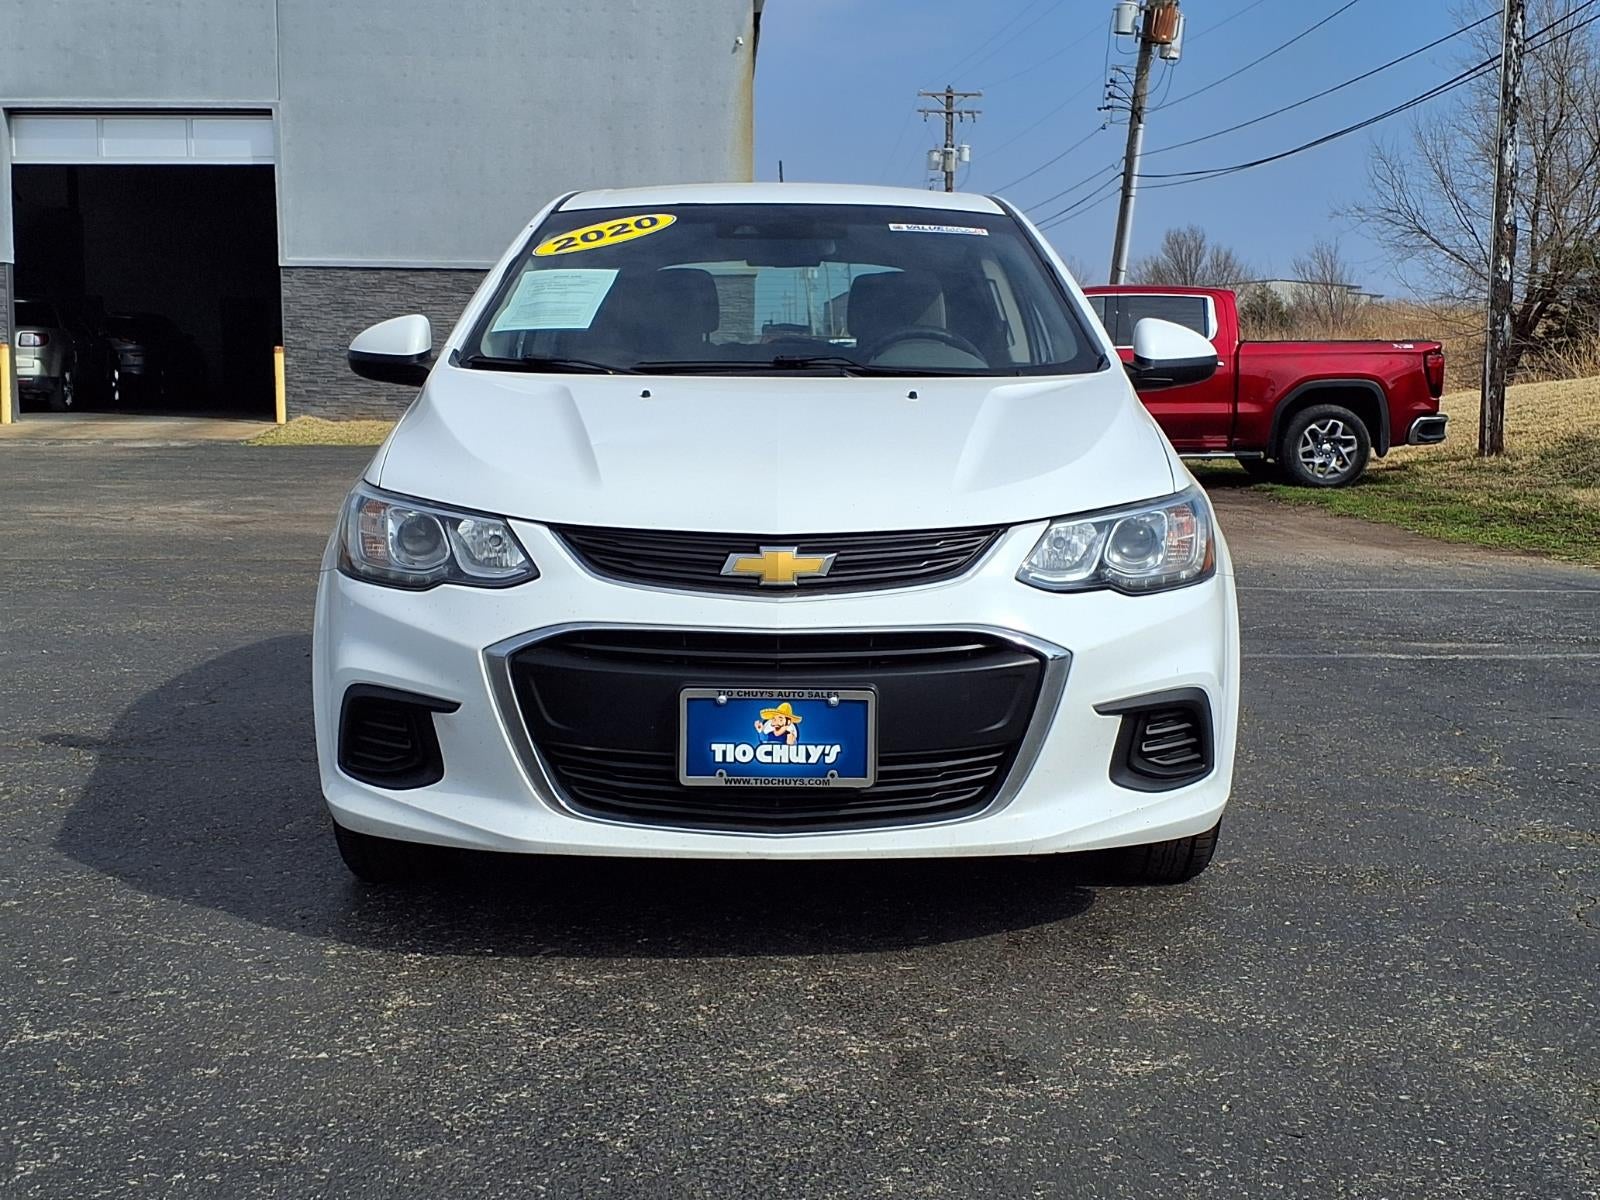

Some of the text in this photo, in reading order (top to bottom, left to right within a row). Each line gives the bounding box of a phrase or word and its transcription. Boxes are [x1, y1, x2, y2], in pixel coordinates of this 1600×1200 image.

[553, 216, 659, 252] 2020
[737, 690, 774, 698] CHUY'S
[807, 691, 840, 699] SALES
[711, 743, 841, 764] TIO CHUY'S
[724, 778, 830, 786] WWW.TIOCHUYS.COM
